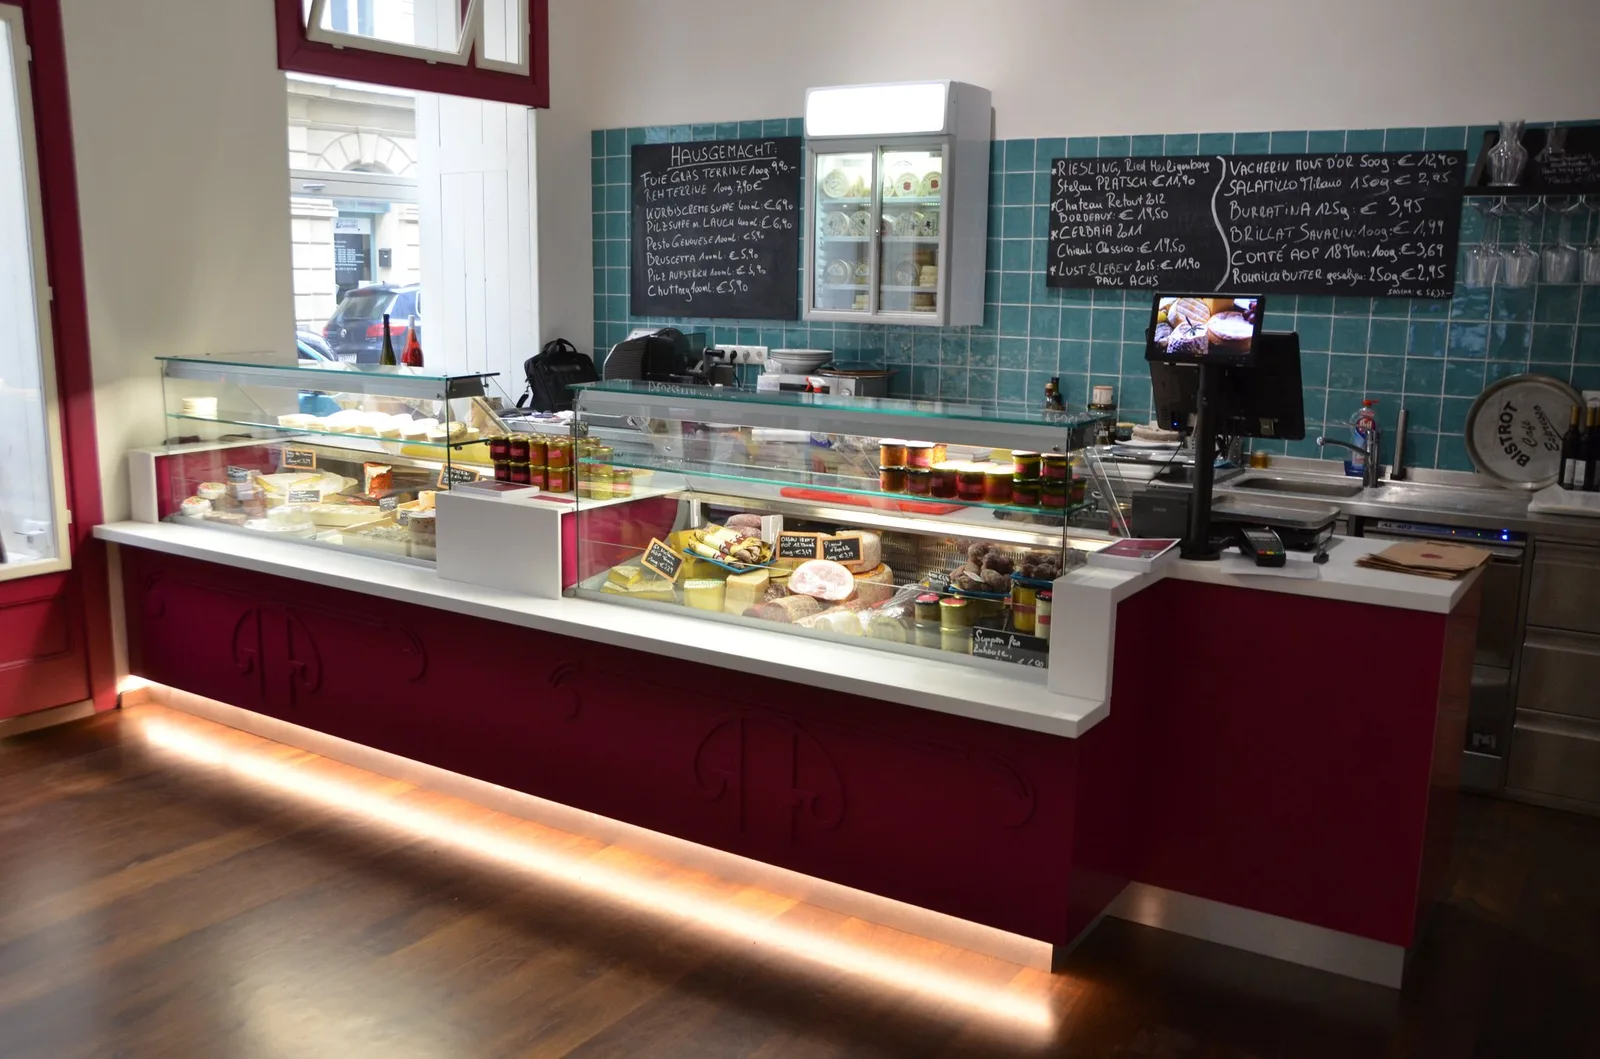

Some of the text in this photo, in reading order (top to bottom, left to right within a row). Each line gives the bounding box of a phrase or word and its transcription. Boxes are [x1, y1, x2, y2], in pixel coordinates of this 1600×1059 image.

[671, 142, 778, 166] HAUSGEMACHT:
[641, 171, 668, 188] FOIE
[671, 169, 699, 184] GRAS
[702, 164, 747, 179] TERRINE
[1230, 160, 1290, 176] VACHERIN
[1300, 176, 1342, 191] Milano
[1229, 200, 1311, 221] BURRATINA
[1360, 202, 1378, 215] €
[1388, 196, 1425, 218] 3,95
[703, 217, 734, 228] LAUCH
[1116, 223, 1142, 239] 2011
[1230, 225, 1296, 243] BRILLAT
[646, 236, 670, 251] Pesto
[646, 252, 696, 266] BRUSCETTA
[1290, 247, 1320, 261] AOP
[1095, 275, 1160, 287] PAUL ACHS
[1498, 401, 1530, 467] BISTROT
[975, 630, 1004, 647] Suppen
